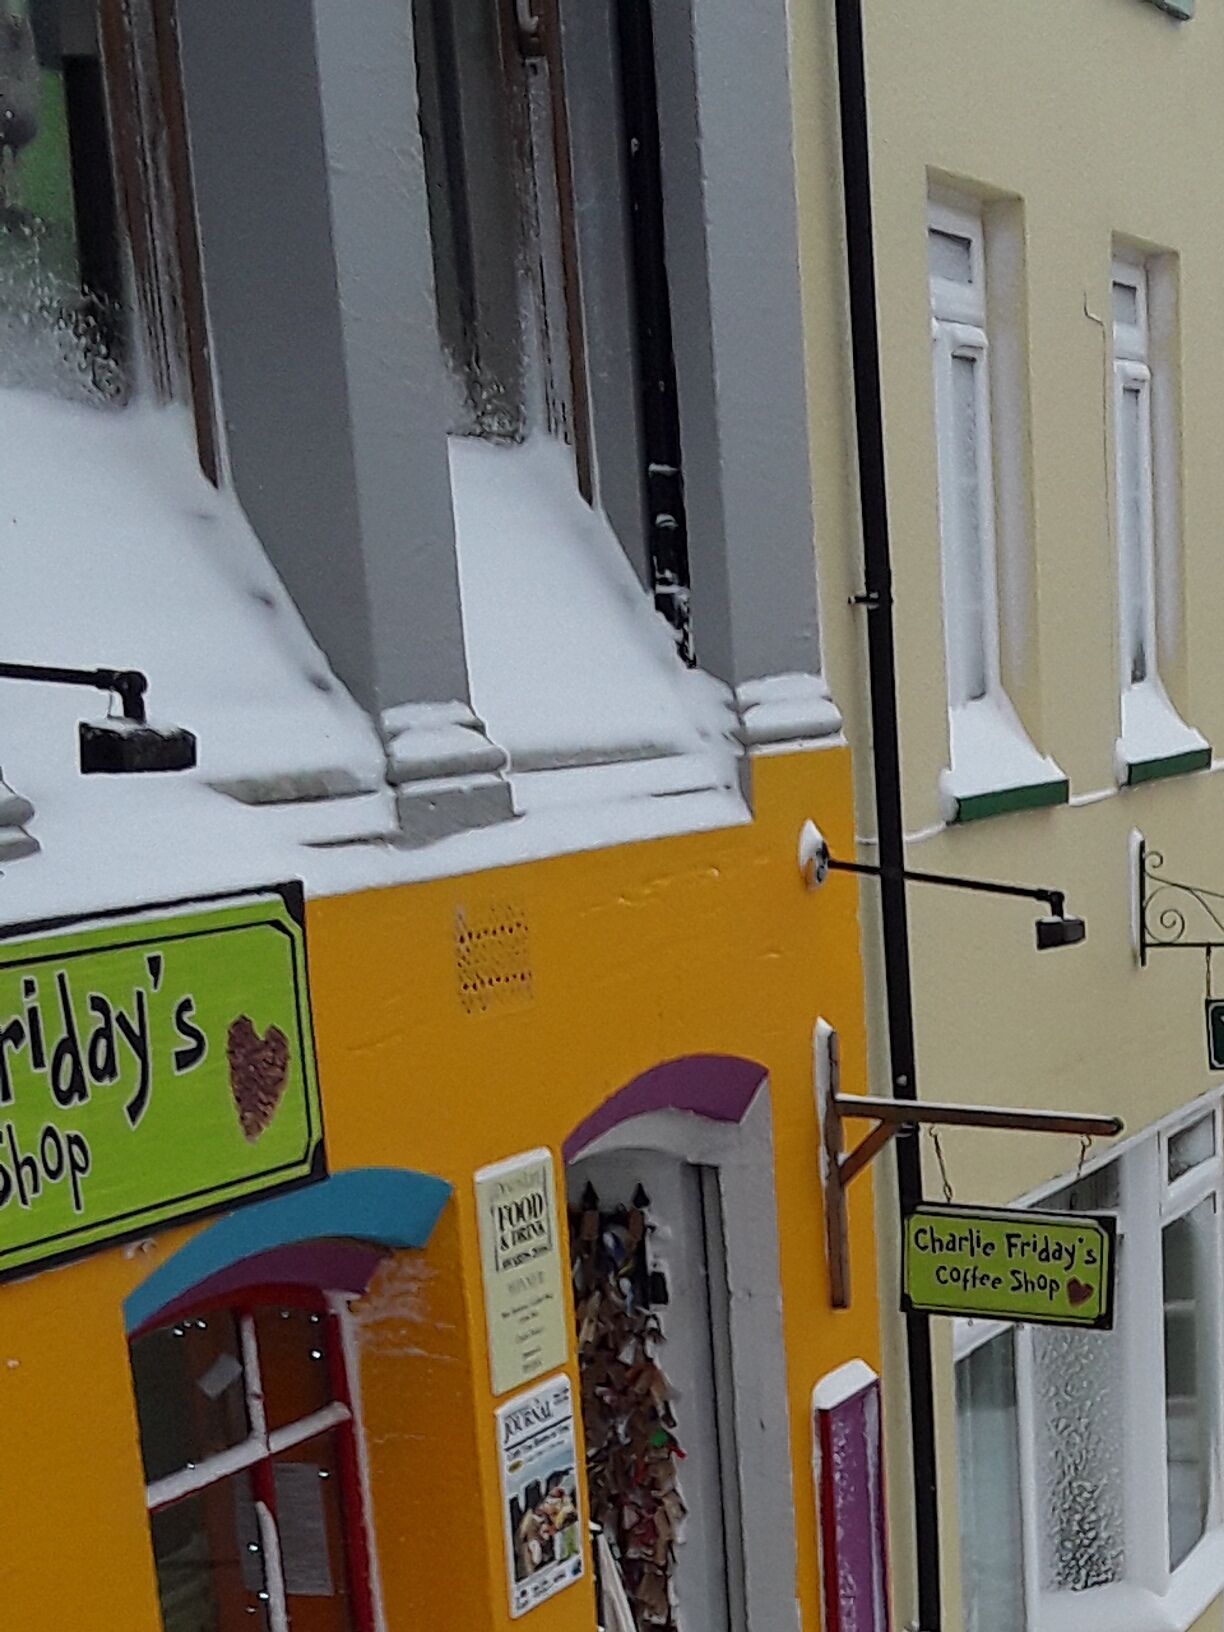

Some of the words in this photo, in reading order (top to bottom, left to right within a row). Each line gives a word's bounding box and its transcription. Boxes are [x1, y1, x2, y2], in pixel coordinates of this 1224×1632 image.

[914, 1225, 995, 1257] Charlie
[1005, 1232, 1098, 1272] Friday's
[935, 1264, 1003, 1292] Coffee
[1009, 1269, 1061, 1301] Shop
